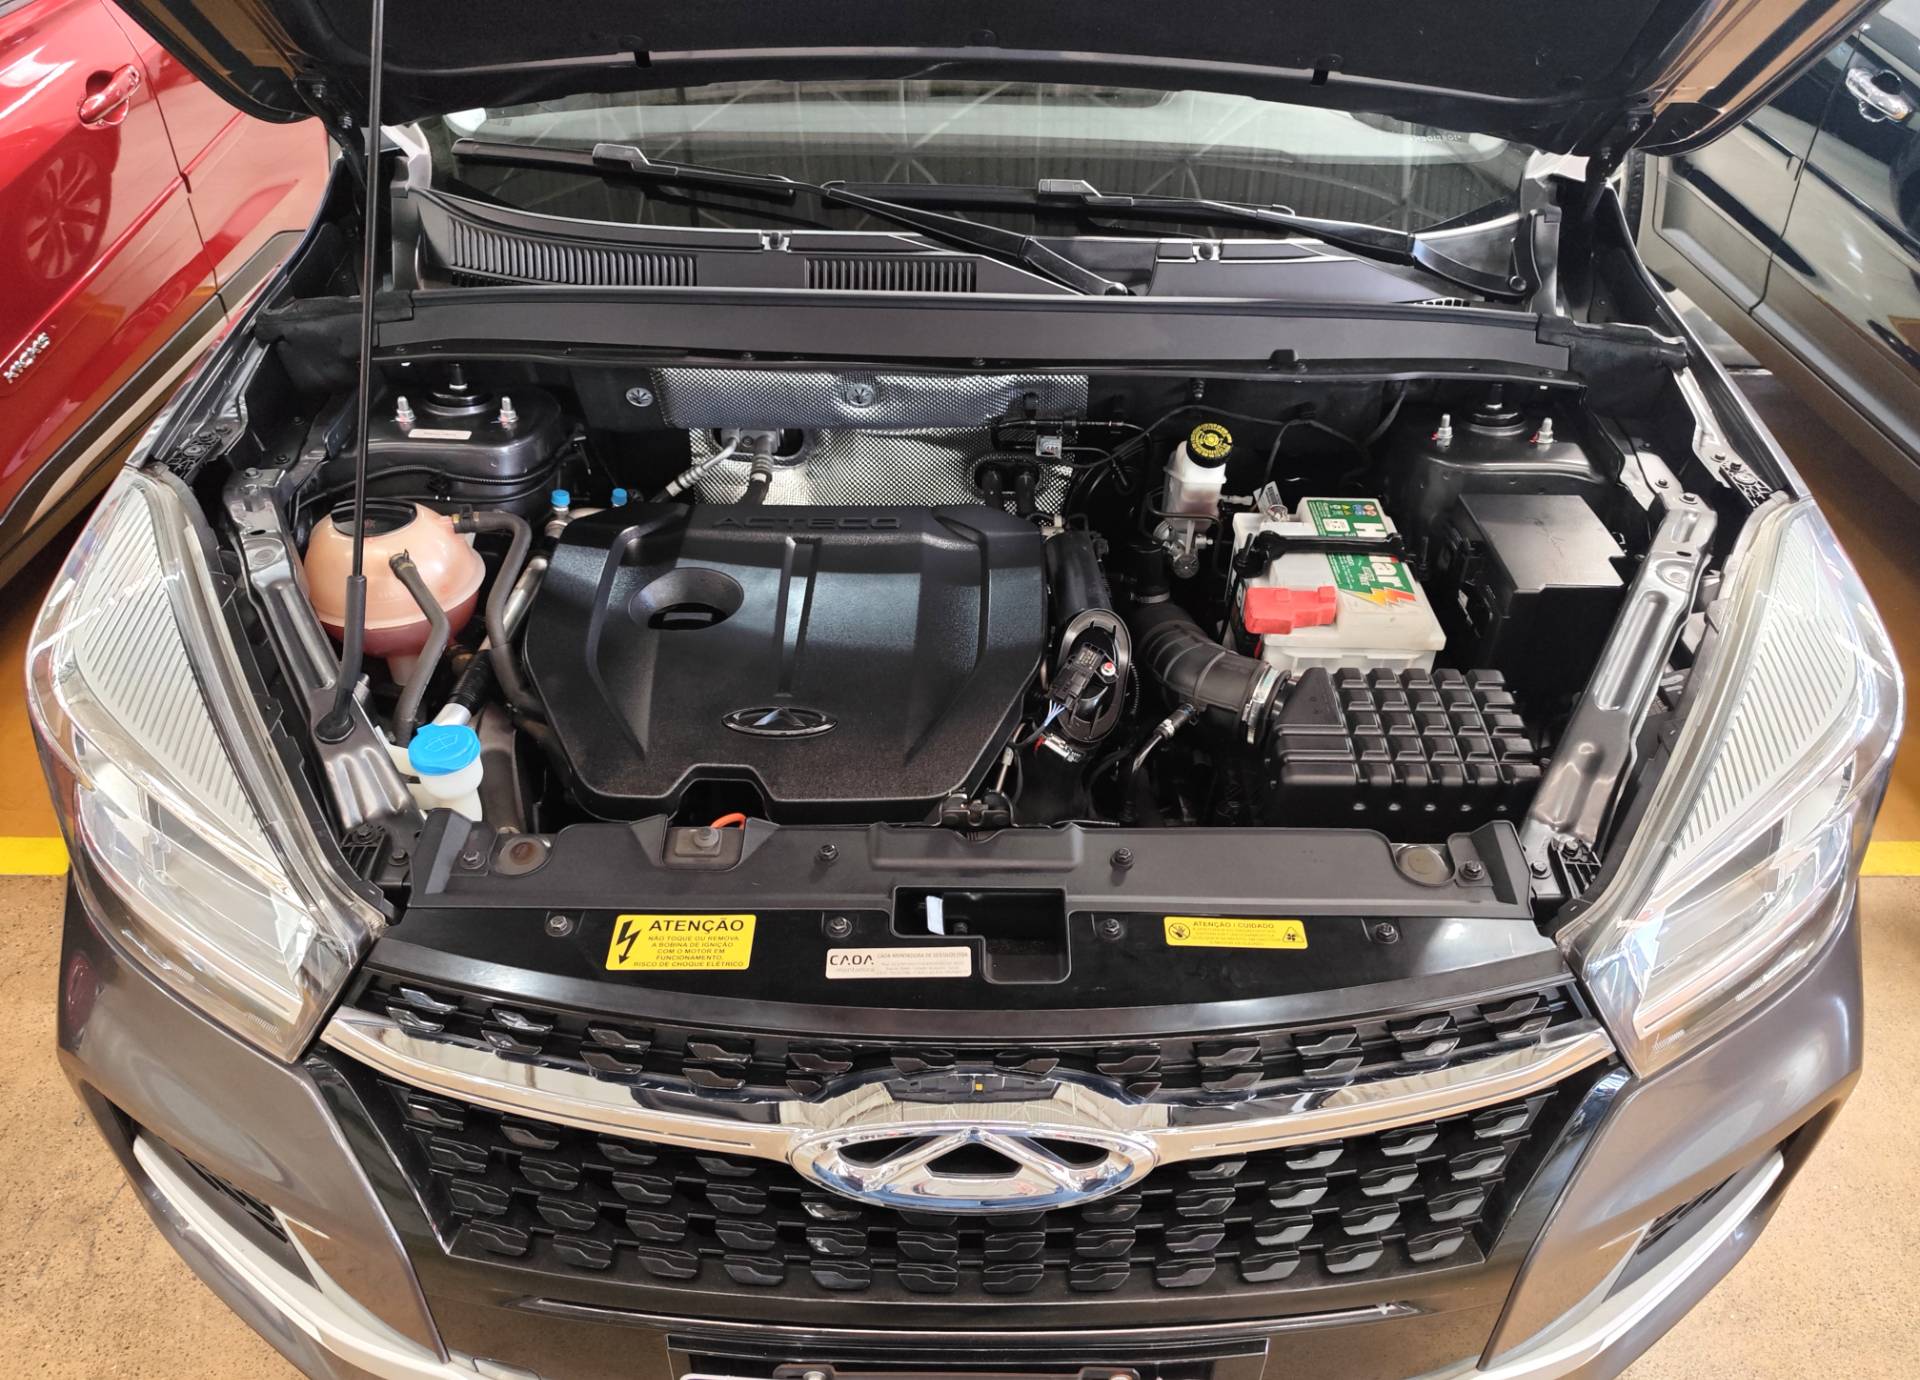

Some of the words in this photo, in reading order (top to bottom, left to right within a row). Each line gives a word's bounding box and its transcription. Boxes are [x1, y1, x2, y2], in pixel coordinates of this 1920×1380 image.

[712, 516, 901, 529] ACTECO
[649, 918, 744, 933] ATENÇÃO
[830, 954, 874, 966] CAOA
